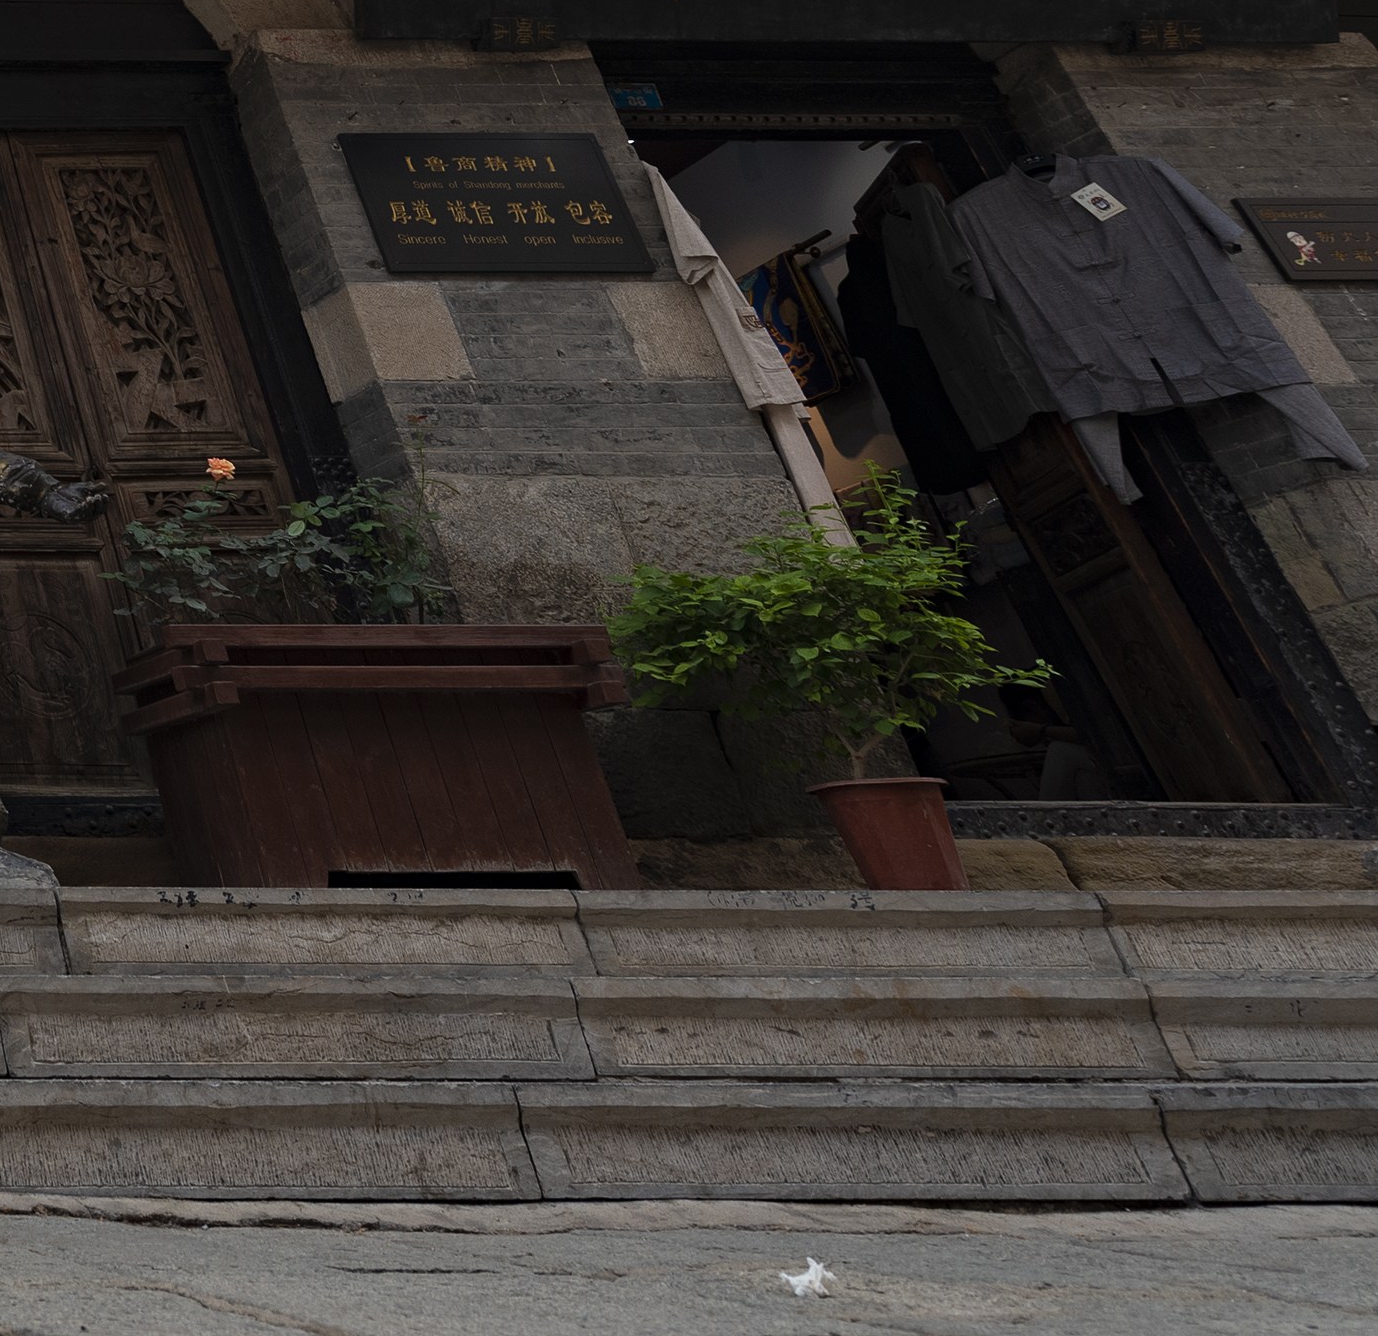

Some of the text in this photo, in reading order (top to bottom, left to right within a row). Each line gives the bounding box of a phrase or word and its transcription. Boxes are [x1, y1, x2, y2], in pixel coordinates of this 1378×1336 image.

[412, 180, 565, 192] Spirits of Shandong merchants
[388, 199, 613, 226] 厚道 诚信 开放 包容
[397, 234, 624, 247] Sincere Honest open Inclusive
